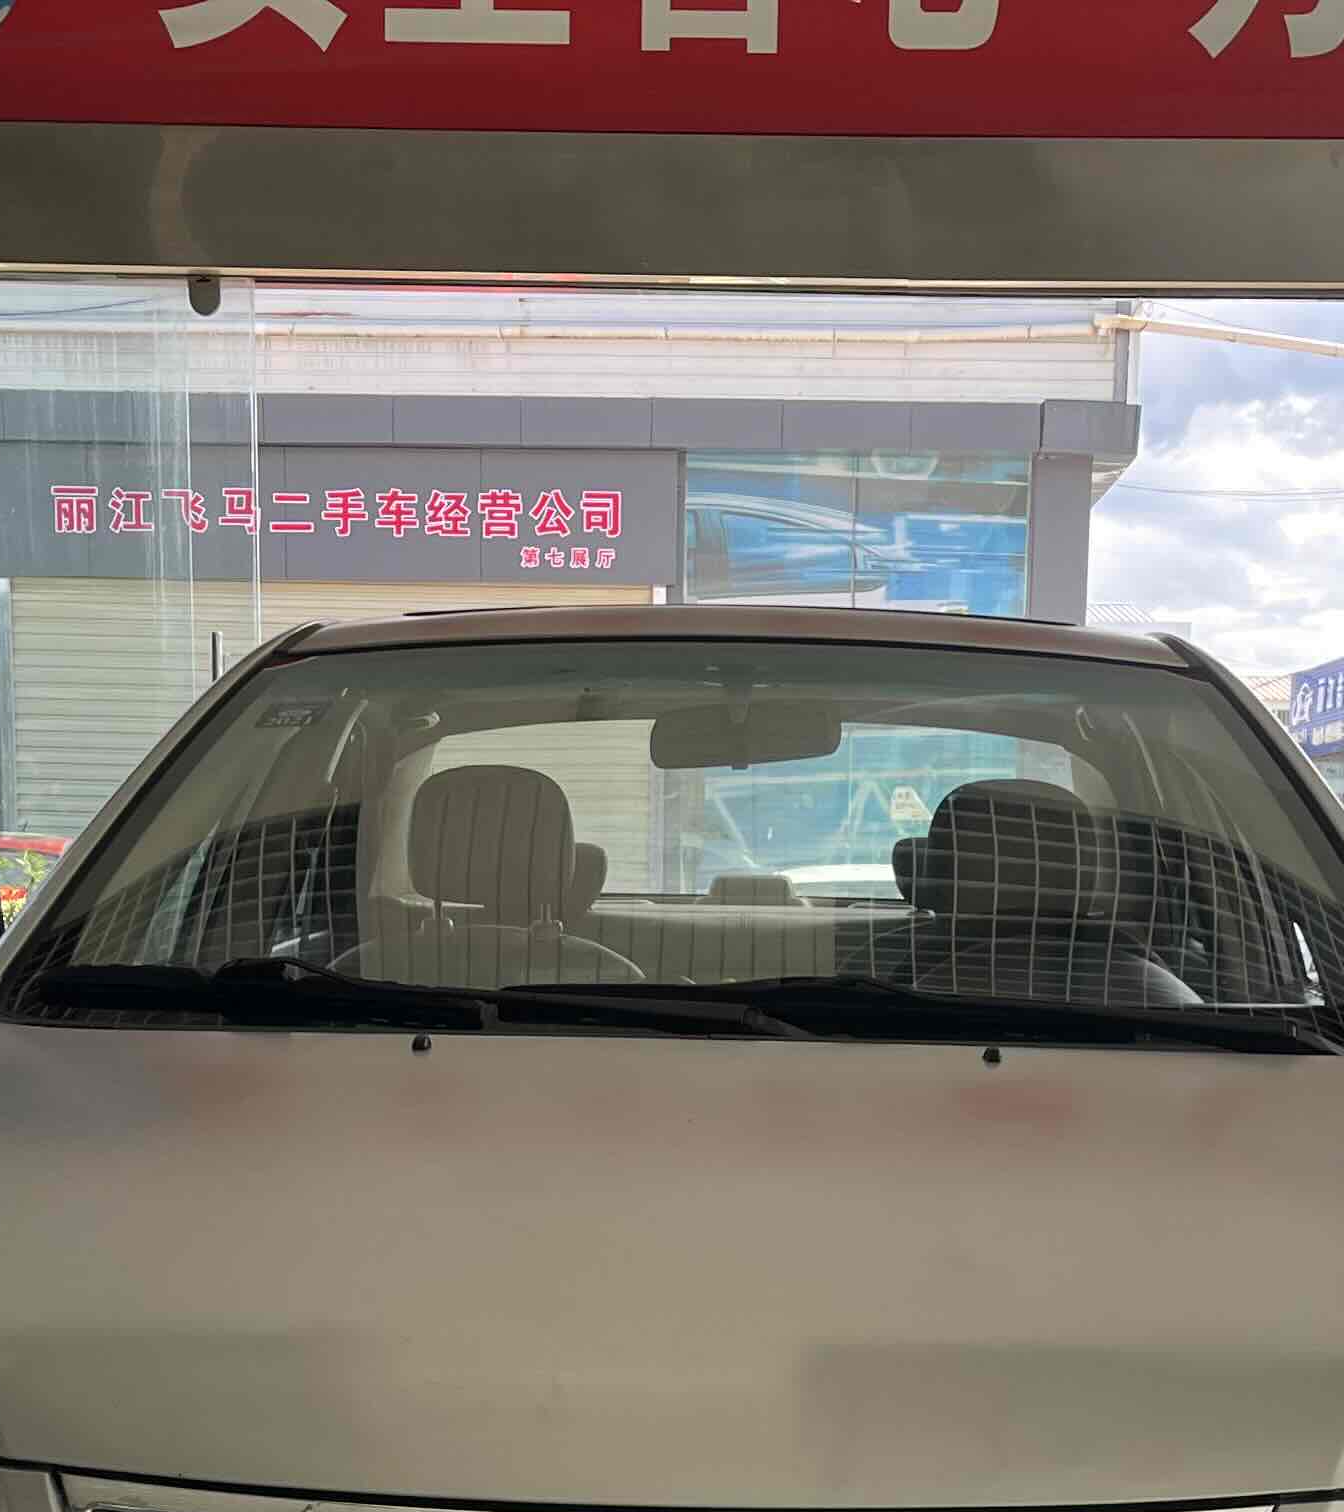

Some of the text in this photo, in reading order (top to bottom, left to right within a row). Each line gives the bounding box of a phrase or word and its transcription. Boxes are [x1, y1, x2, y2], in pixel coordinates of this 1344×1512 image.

[51, 485, 624, 538] 丽江飞马二手车经营公司
[520, 546, 616, 568] 第七展厅
